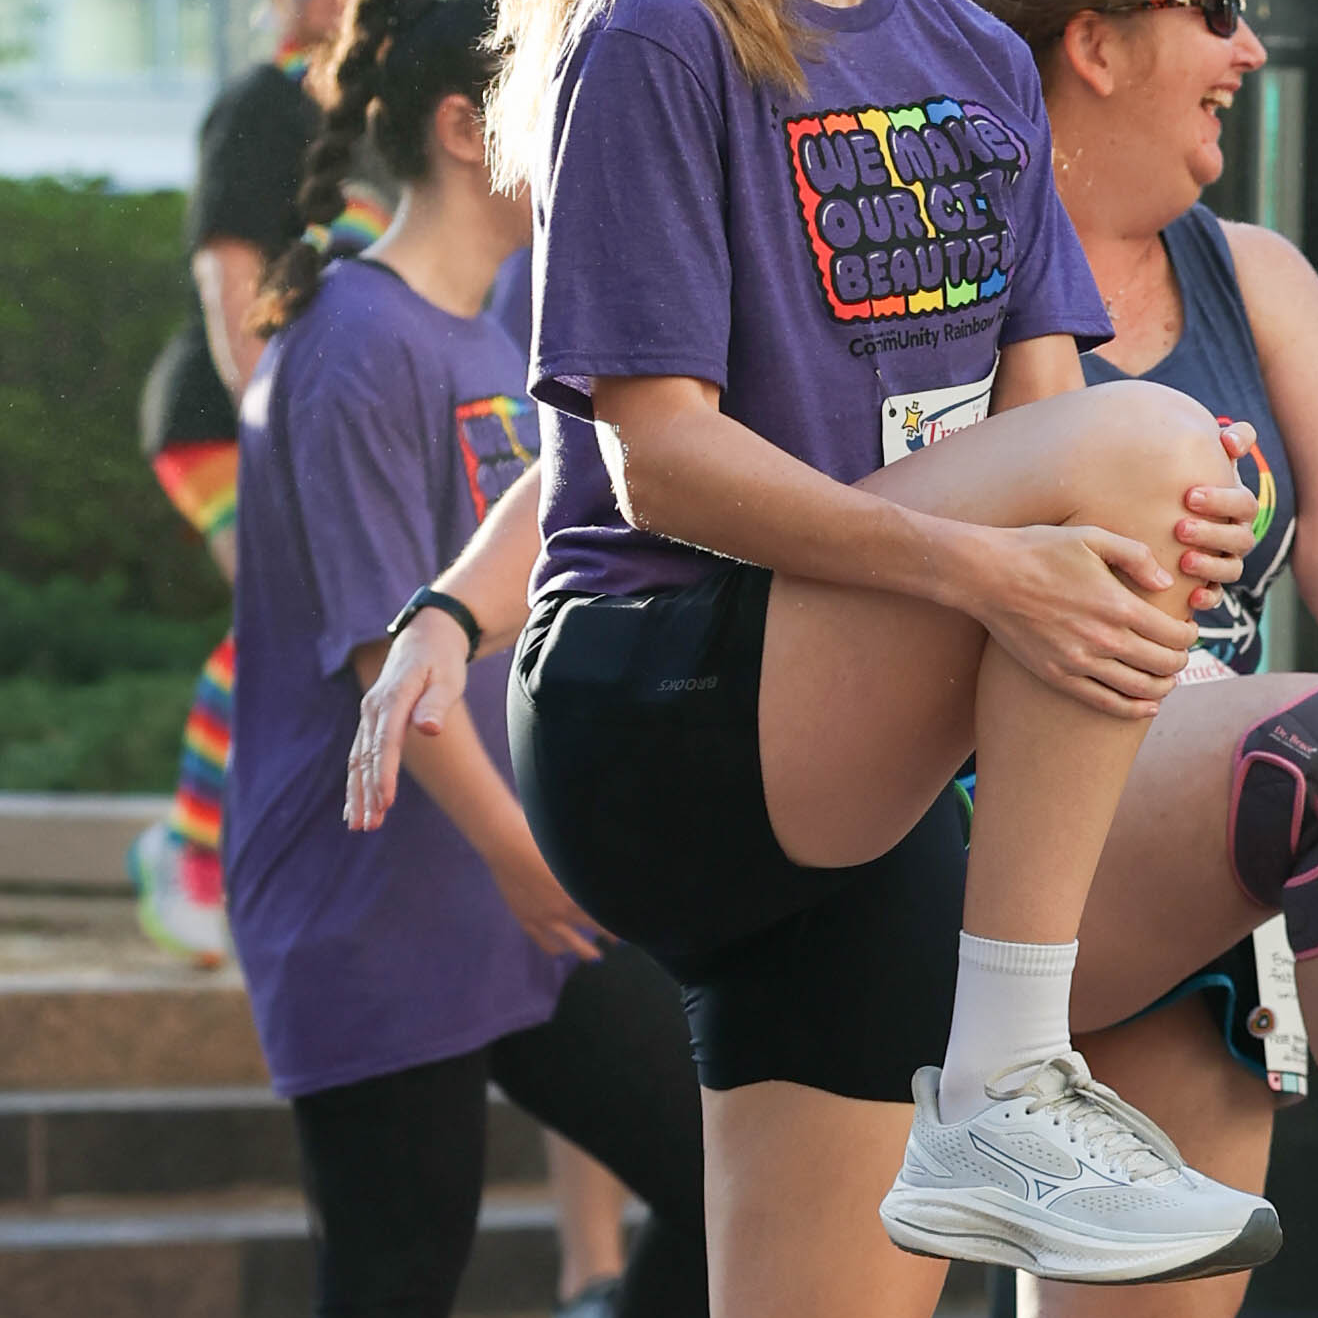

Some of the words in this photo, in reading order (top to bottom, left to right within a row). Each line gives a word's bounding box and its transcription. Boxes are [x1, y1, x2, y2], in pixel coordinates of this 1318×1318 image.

[803, 129, 889, 193] WE
[820, 192, 922, 250] OUR
[944, 316, 995, 342] Rainbow
[656, 675, 719, 692] BROOKS
